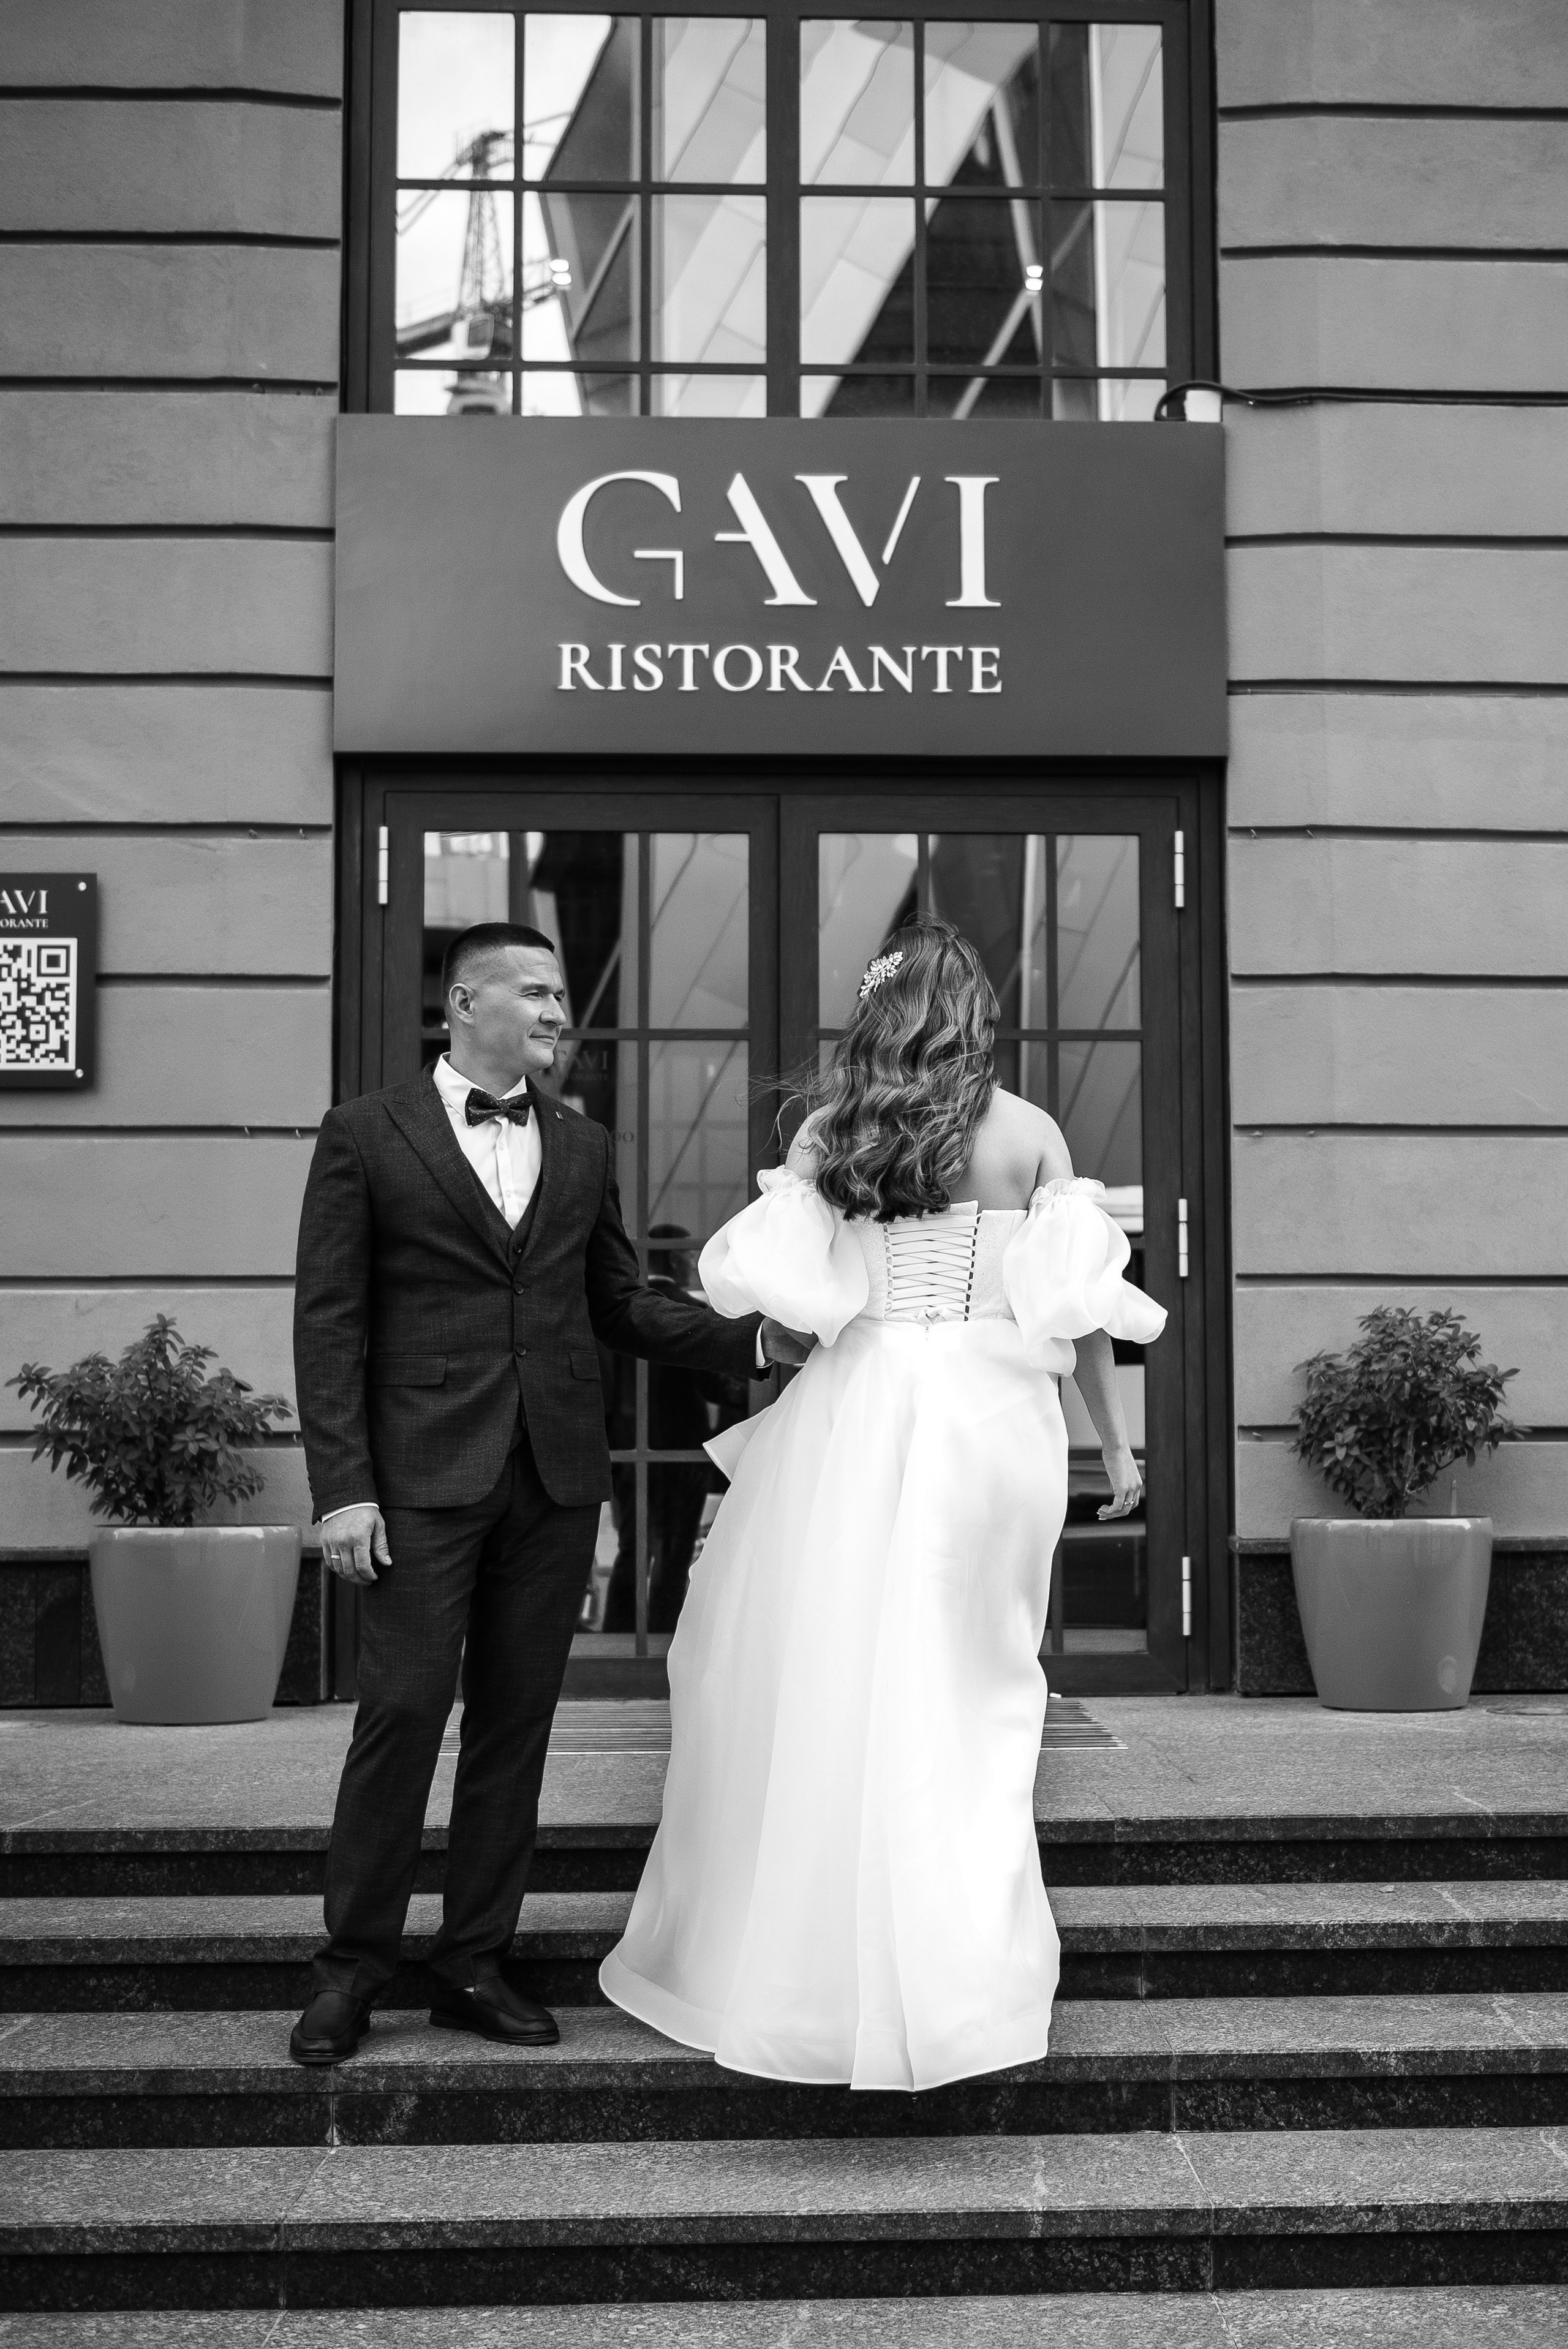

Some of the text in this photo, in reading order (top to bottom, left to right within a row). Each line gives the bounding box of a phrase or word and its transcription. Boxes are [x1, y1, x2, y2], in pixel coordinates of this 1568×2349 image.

[557, 470, 1001, 607] GAVI
[557, 644, 1003, 693] RISTORANTE
[558, 1050, 608, 1069] AVI
